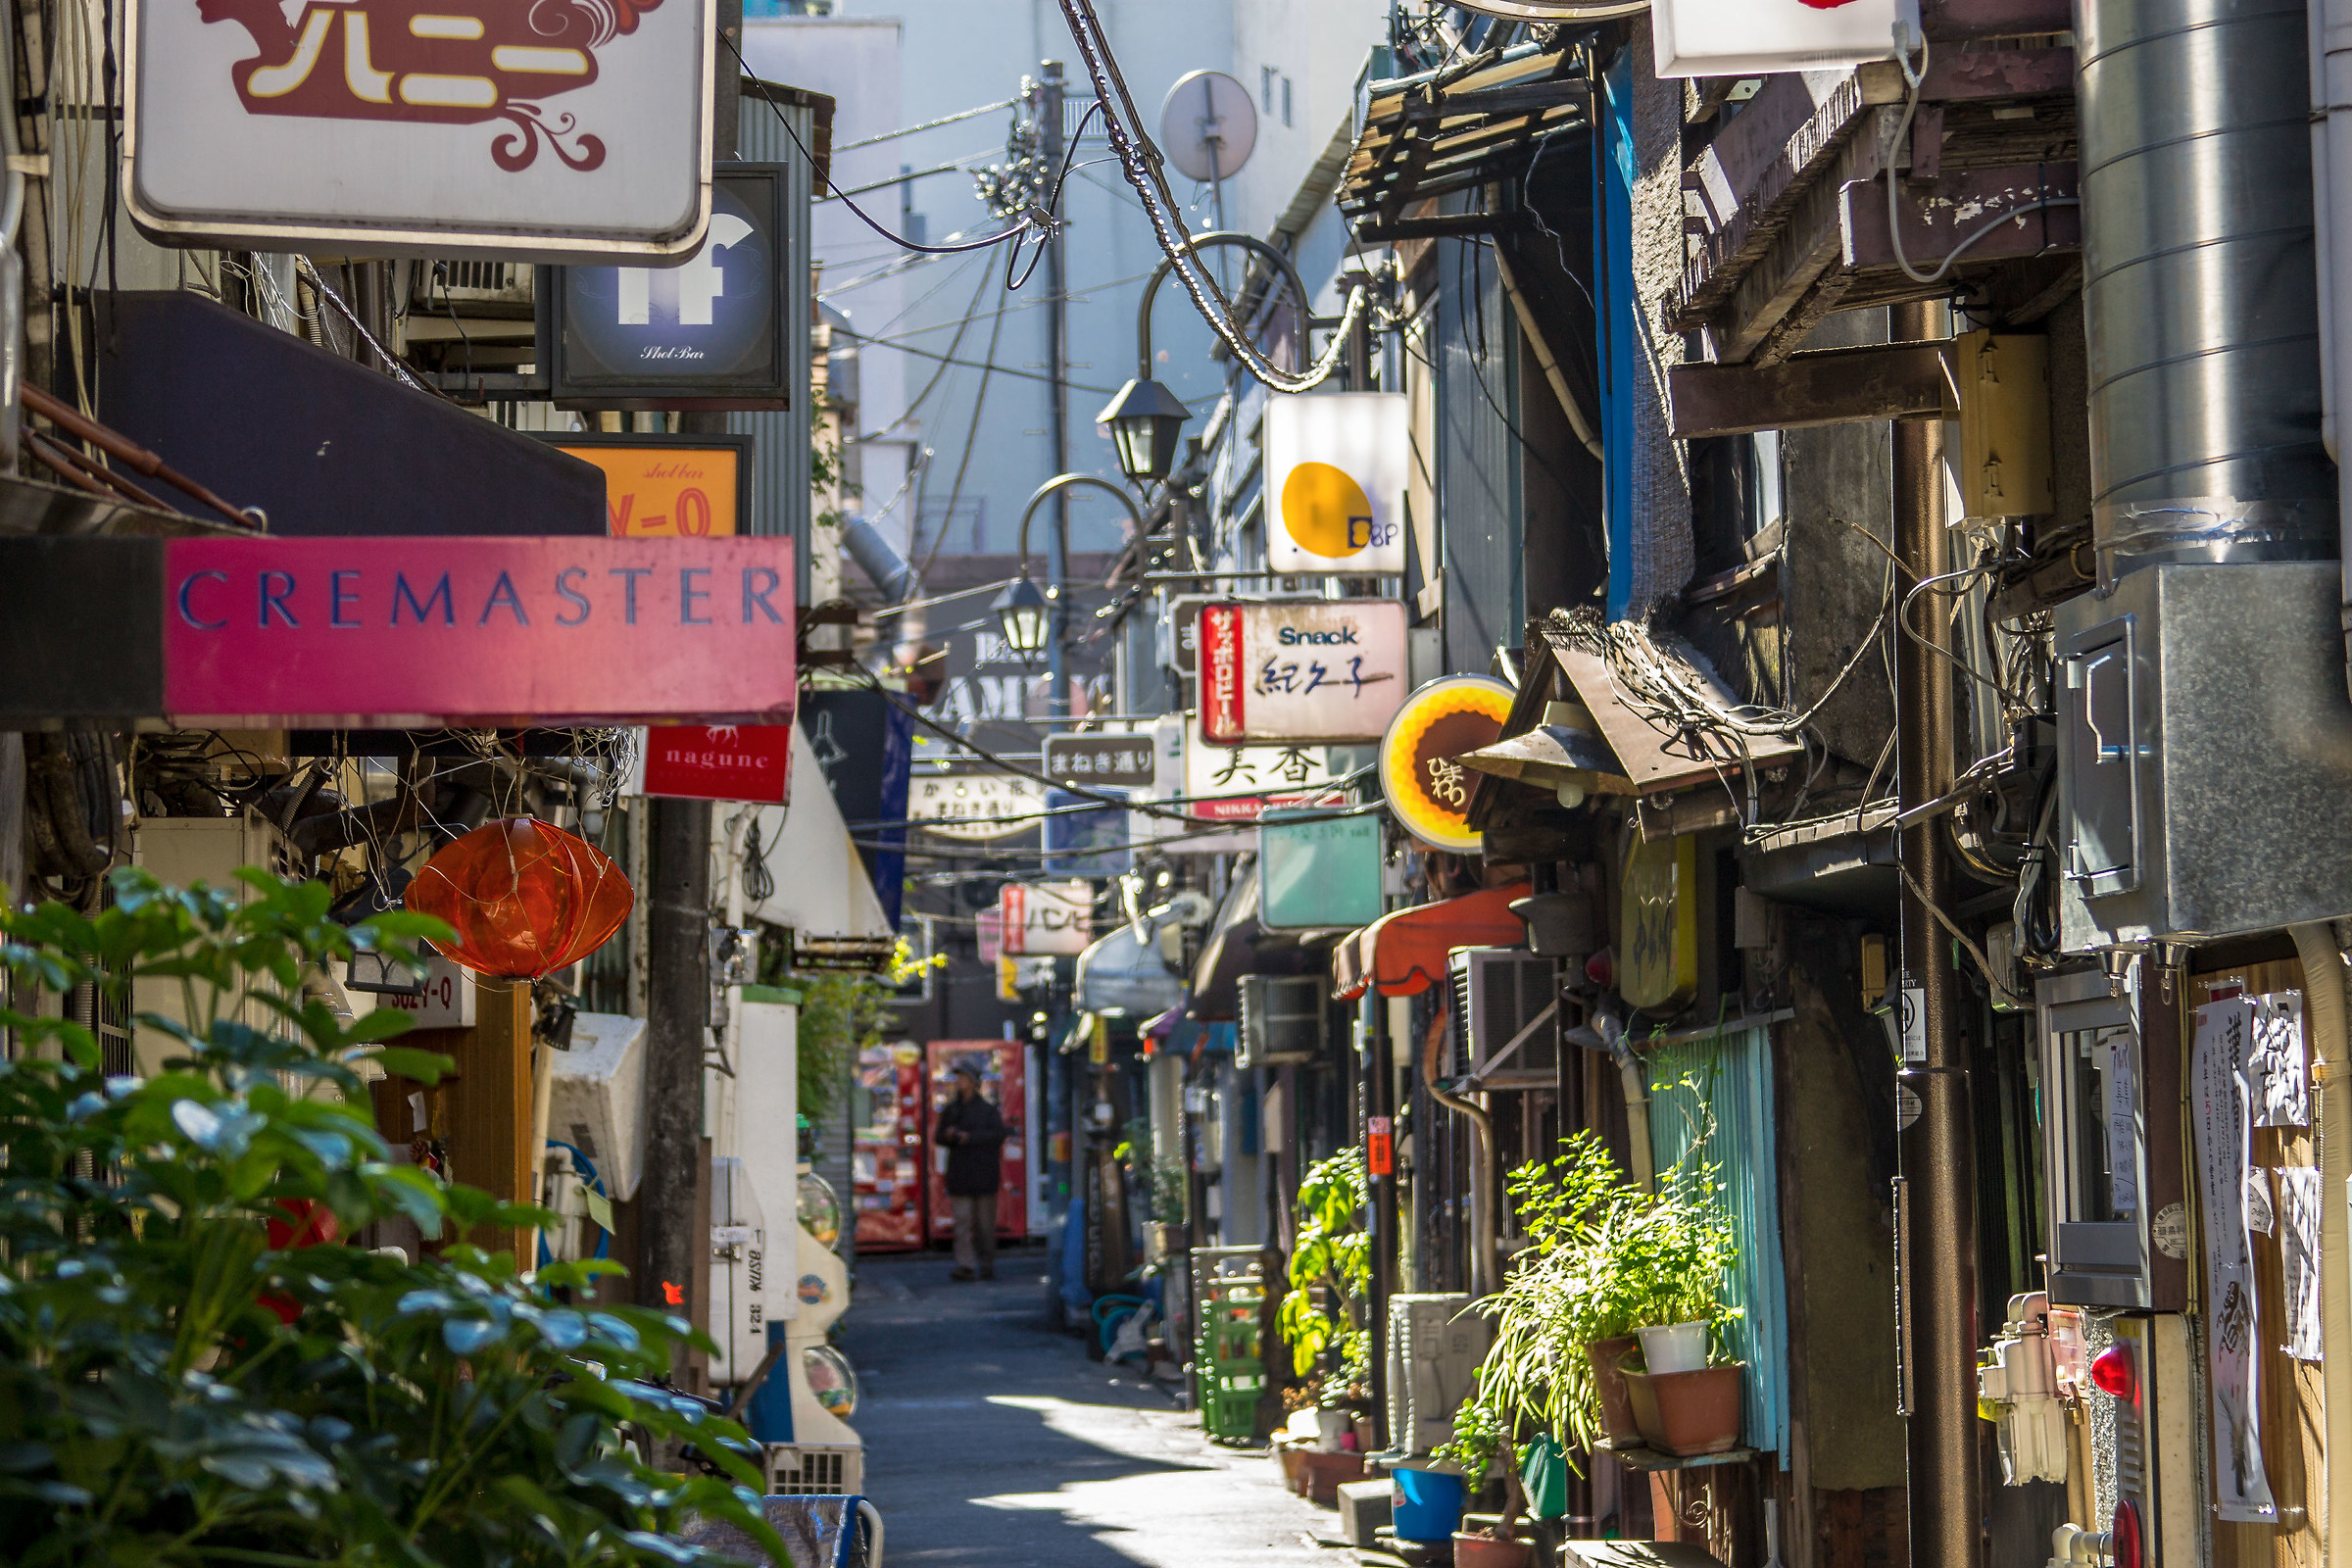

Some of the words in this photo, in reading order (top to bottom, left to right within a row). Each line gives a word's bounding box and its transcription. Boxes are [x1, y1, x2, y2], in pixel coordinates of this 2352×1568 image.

[674, 346, 705, 360] Bar
[177, 567, 782, 630] CREMASTER
[1278, 626, 1358, 646] Snack
[1052, 751, 1152, 774] まねき通り
